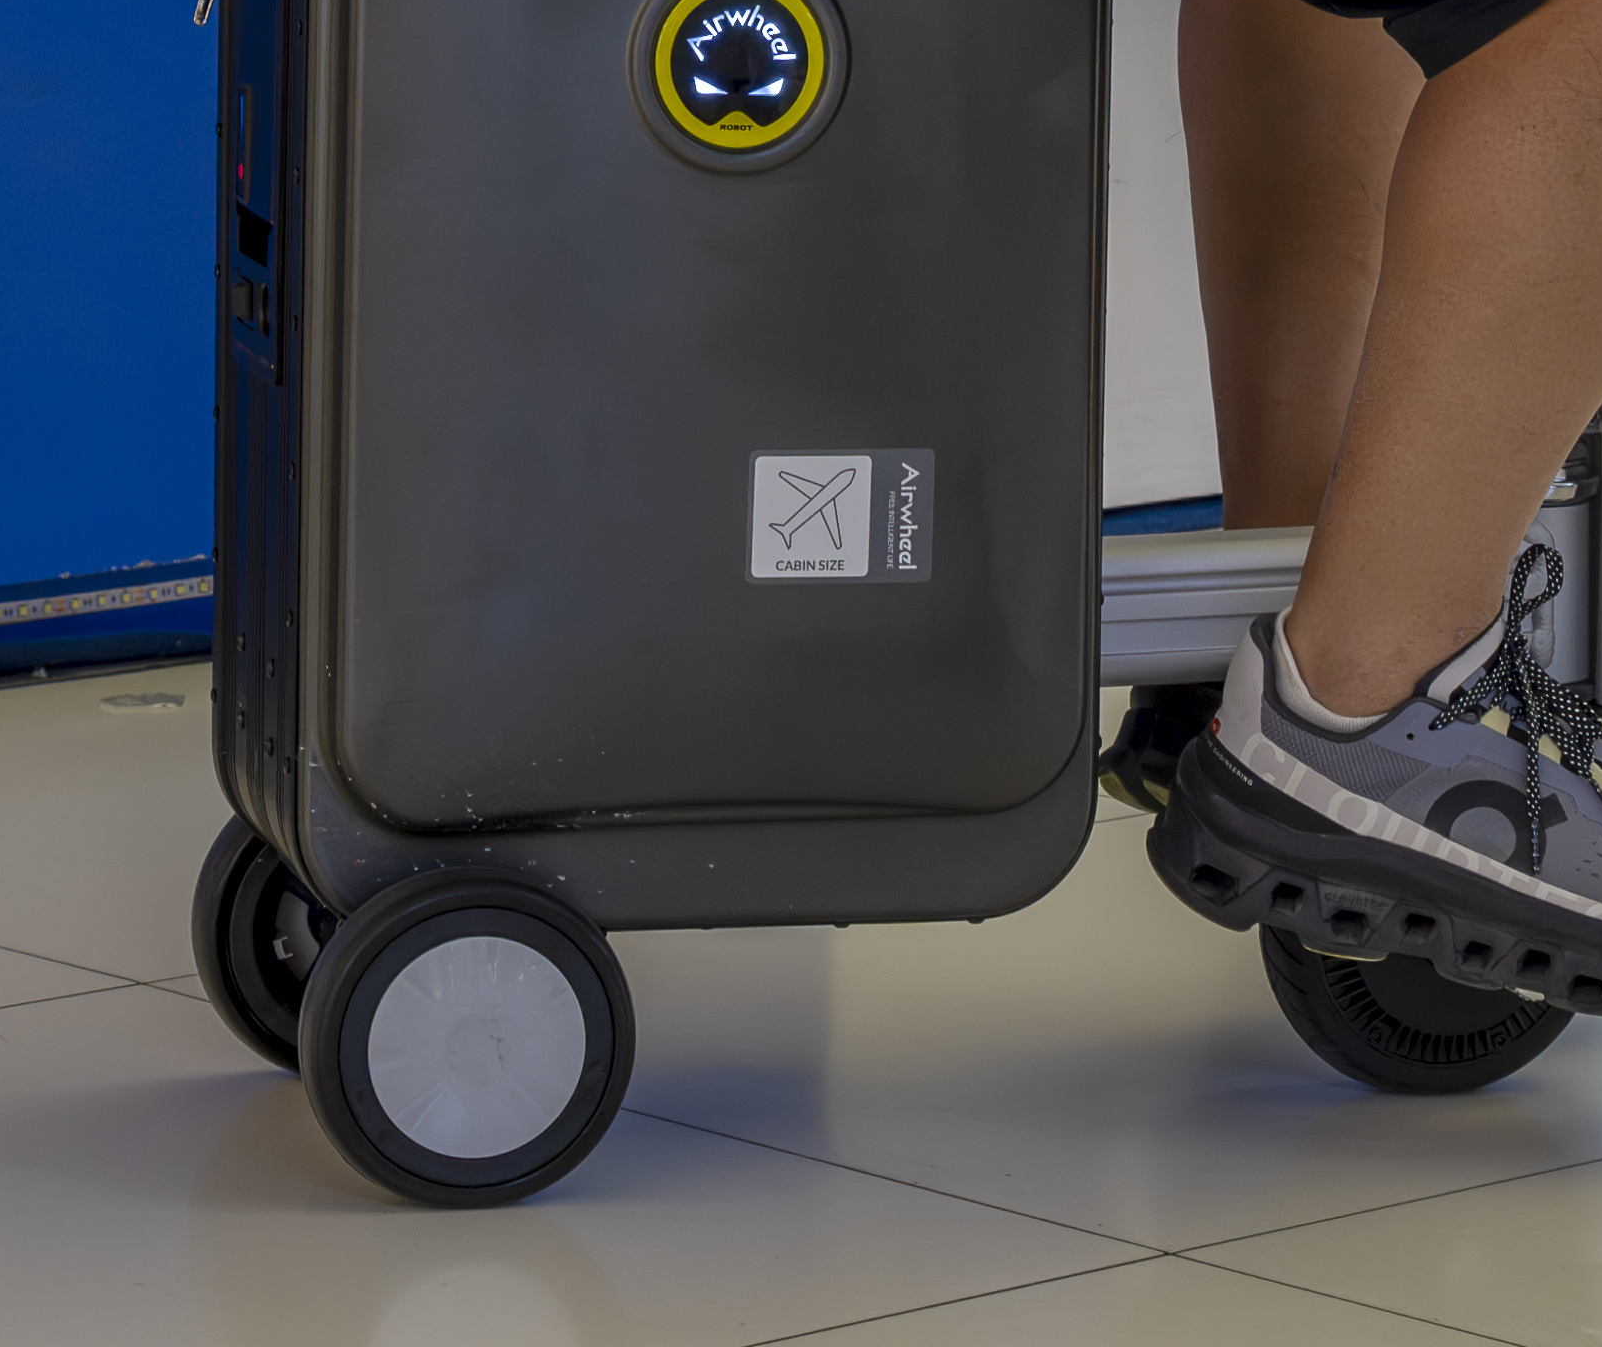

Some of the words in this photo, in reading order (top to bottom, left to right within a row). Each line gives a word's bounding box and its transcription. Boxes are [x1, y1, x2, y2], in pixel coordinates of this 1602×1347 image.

[687, 4, 797, 62] Airwheel
[719, 123, 754, 133] ROBOT
[898, 461, 921, 570] Airwheel
[775, 559, 817, 573] CABIN
[817, 559, 846, 572] SIZE
